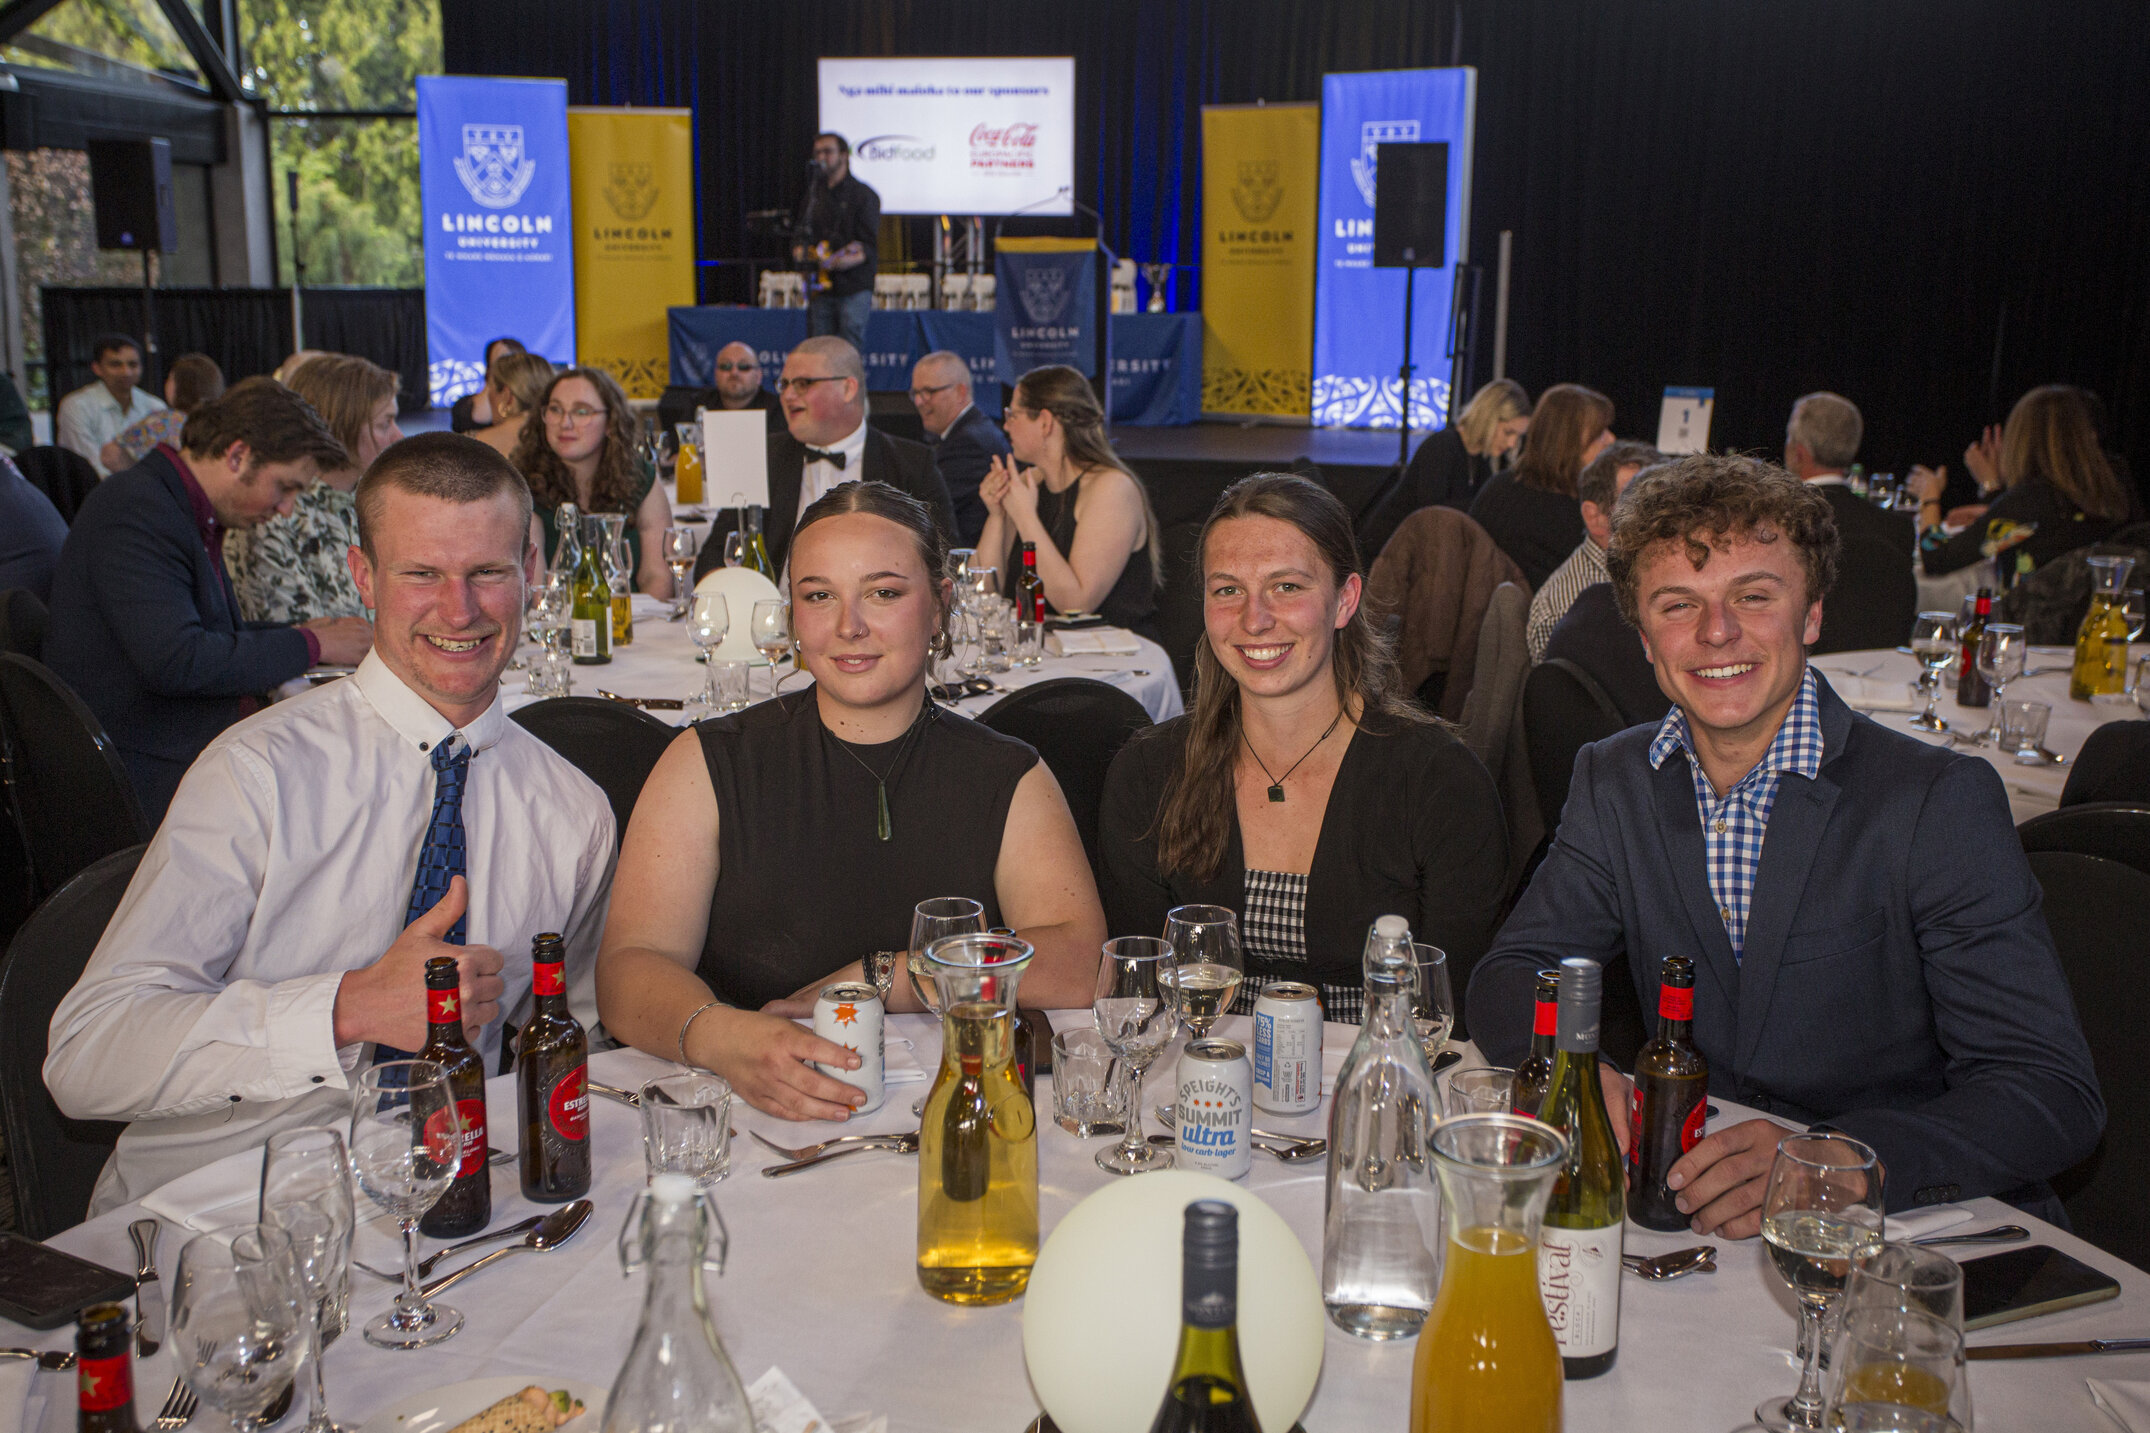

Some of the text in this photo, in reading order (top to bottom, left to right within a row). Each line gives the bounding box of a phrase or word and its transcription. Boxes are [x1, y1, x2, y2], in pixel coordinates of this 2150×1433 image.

[949, 85, 959, 95] to
[965, 86, 984, 95] our
[990, 86, 1049, 98] sponsors
[970, 160, 1034, 168] PARTNERS
[442, 213, 552, 233] LINCOLN
[594, 228, 673, 241] LINCOLN
[1219, 231, 1294, 243] LINCOLN
[457, 235, 539, 249] UNIVERSITY
[1012, 327, 1080, 339] LINCOLN
[1683, 408, 1690, 424] 1
[1257, 1015, 1272, 1029] 75%
[1257, 1025, 1272, 1039] LESS
[1180, 1079, 1241, 1107] SPEIGHT'S
[1178, 1103, 1242, 1127] SUMMIT
[1182, 1124, 1236, 1147] ultra
[1181, 1141, 1236, 1159] low carb lager
